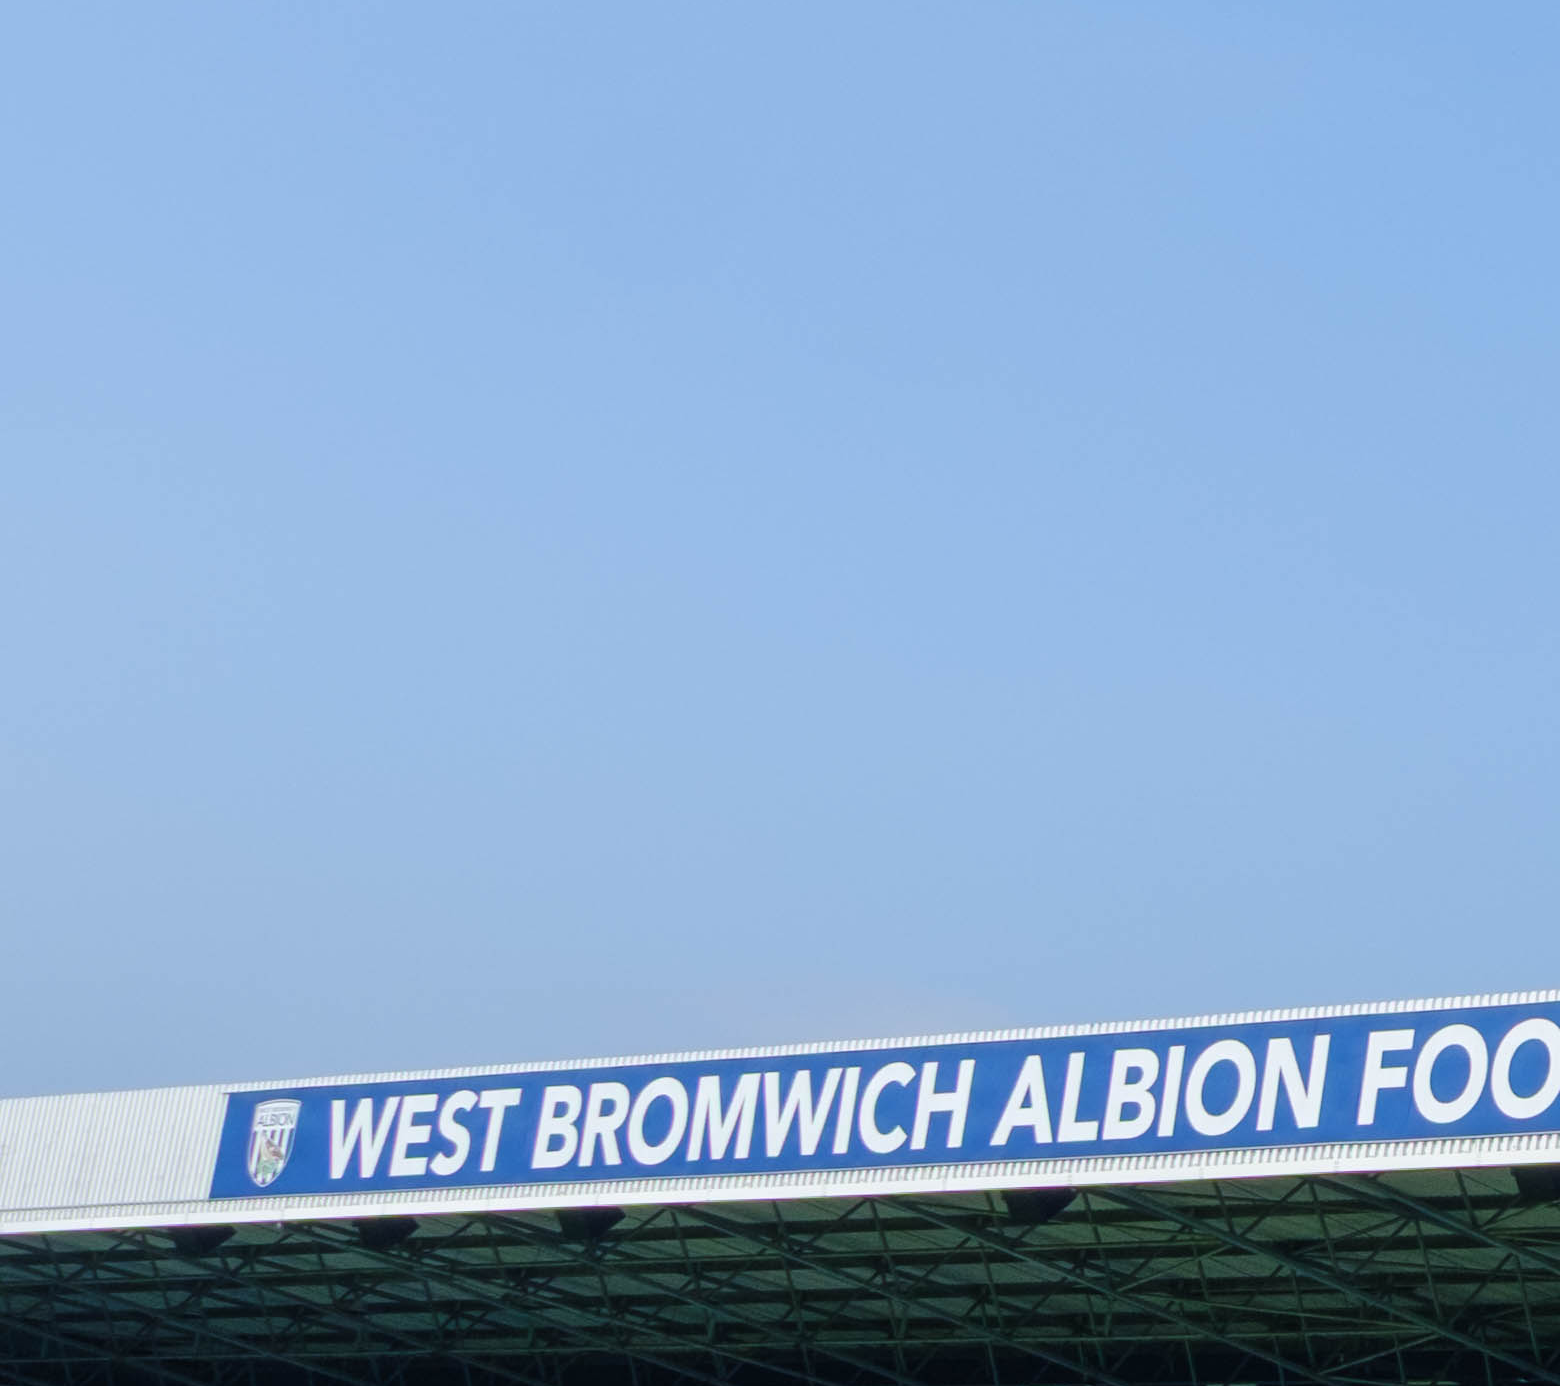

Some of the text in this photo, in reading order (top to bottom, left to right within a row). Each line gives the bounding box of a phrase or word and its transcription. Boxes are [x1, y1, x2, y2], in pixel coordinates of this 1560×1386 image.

[258, 1113, 295, 1127] ALBION
[329, 1089, 521, 1180] WEST
[531, 1060, 975, 1169] BROMWICH
[990, 1034, 1331, 1146] ALBION
